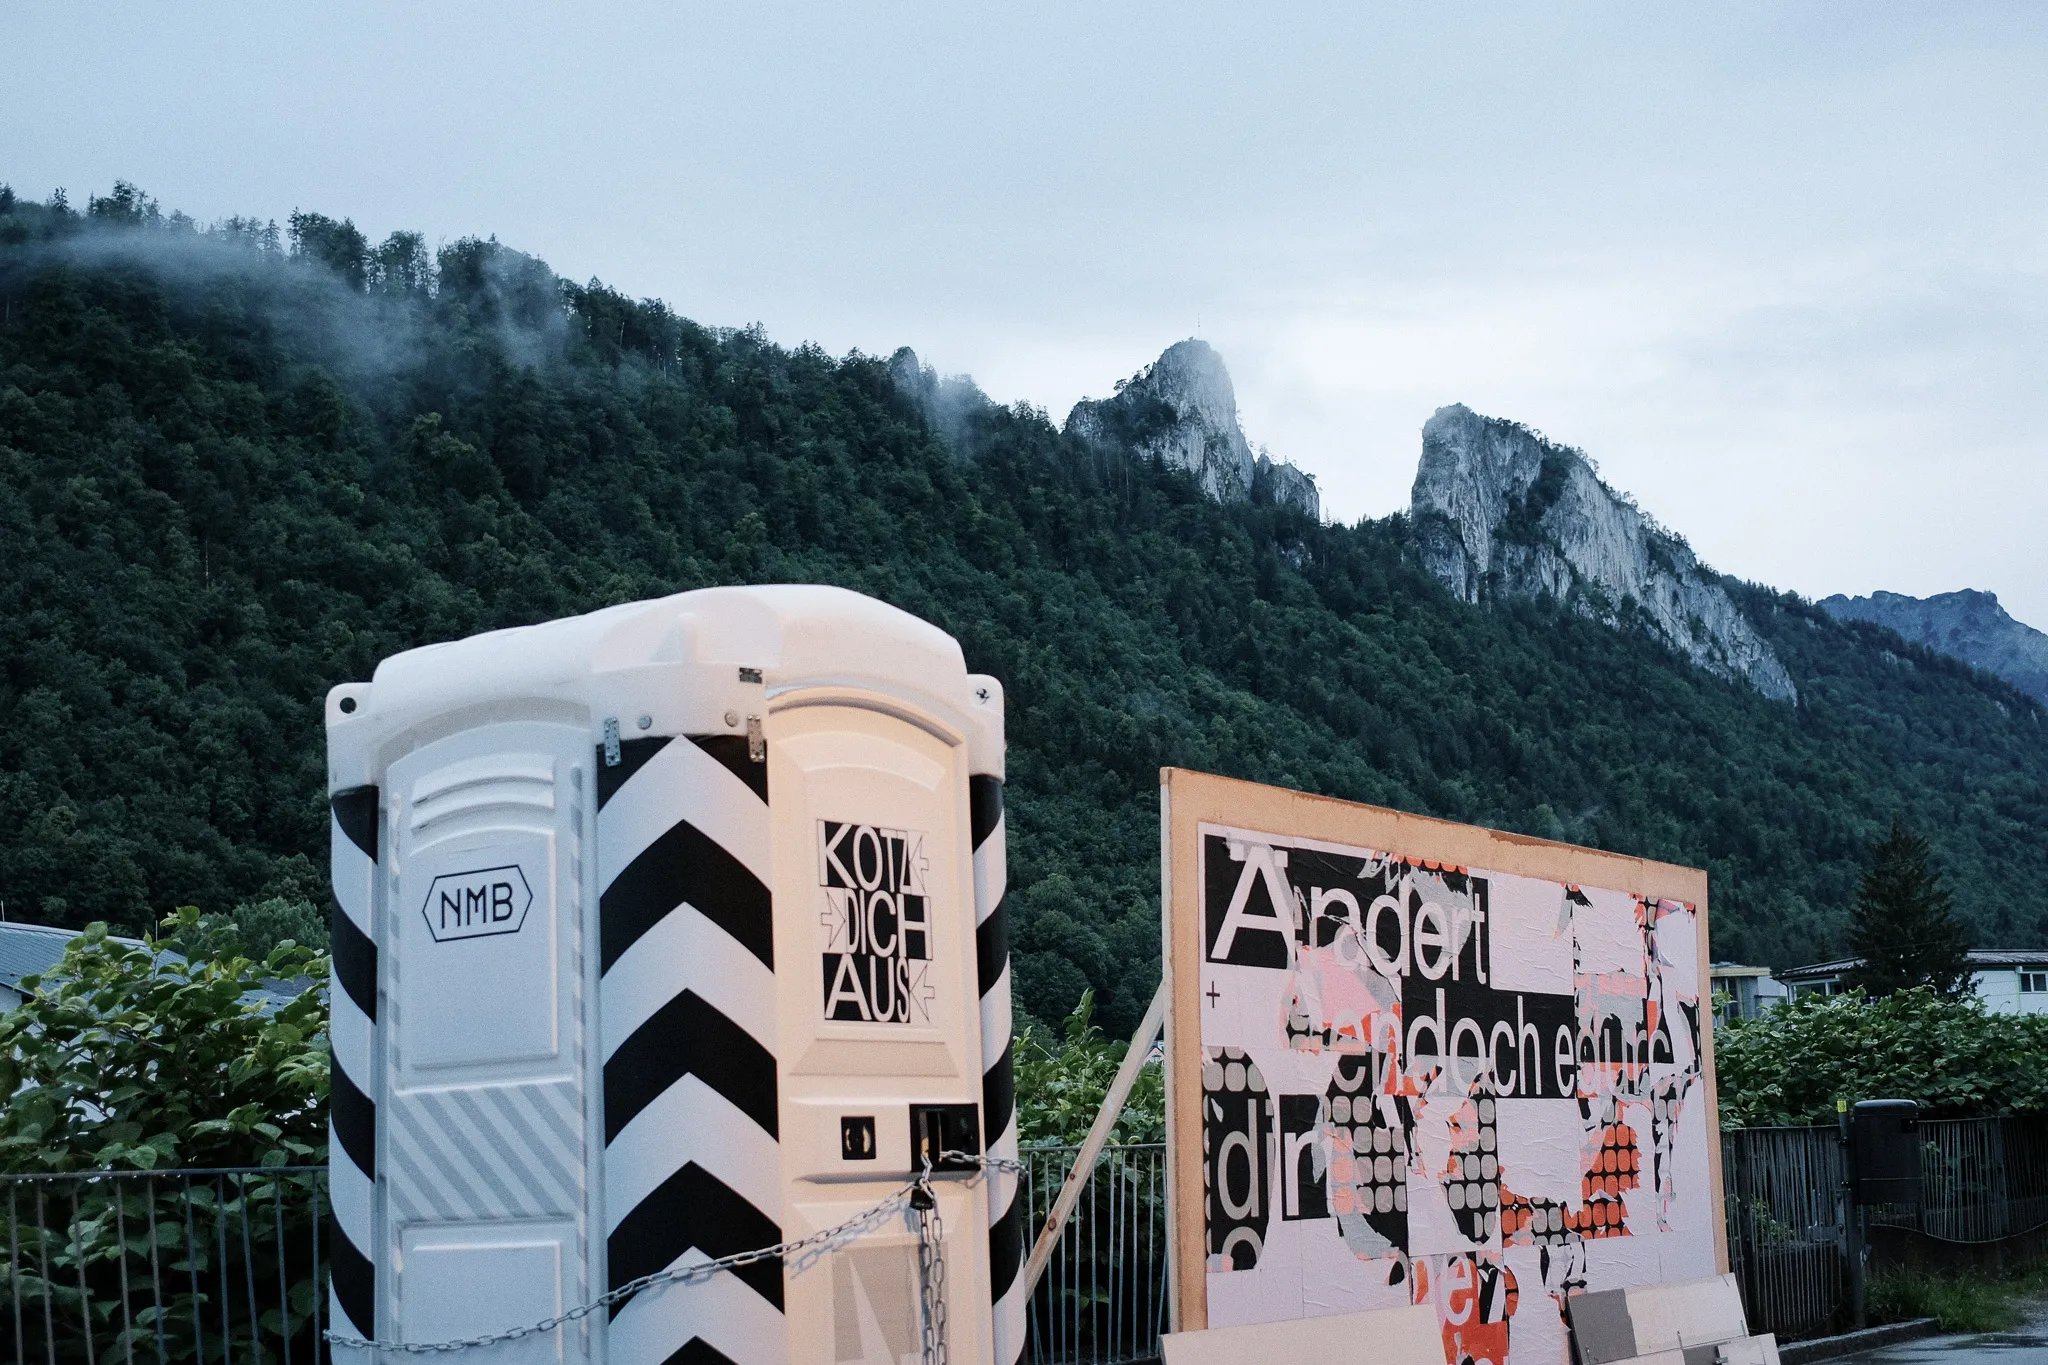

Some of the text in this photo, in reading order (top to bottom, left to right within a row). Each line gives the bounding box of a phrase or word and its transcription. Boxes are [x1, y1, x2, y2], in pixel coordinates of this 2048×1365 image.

[818, 820, 912, 894] KOTZ
[441, 882, 513, 929] NMB
[845, 887, 933, 961] DICH
[825, 953, 910, 1023] AUS
